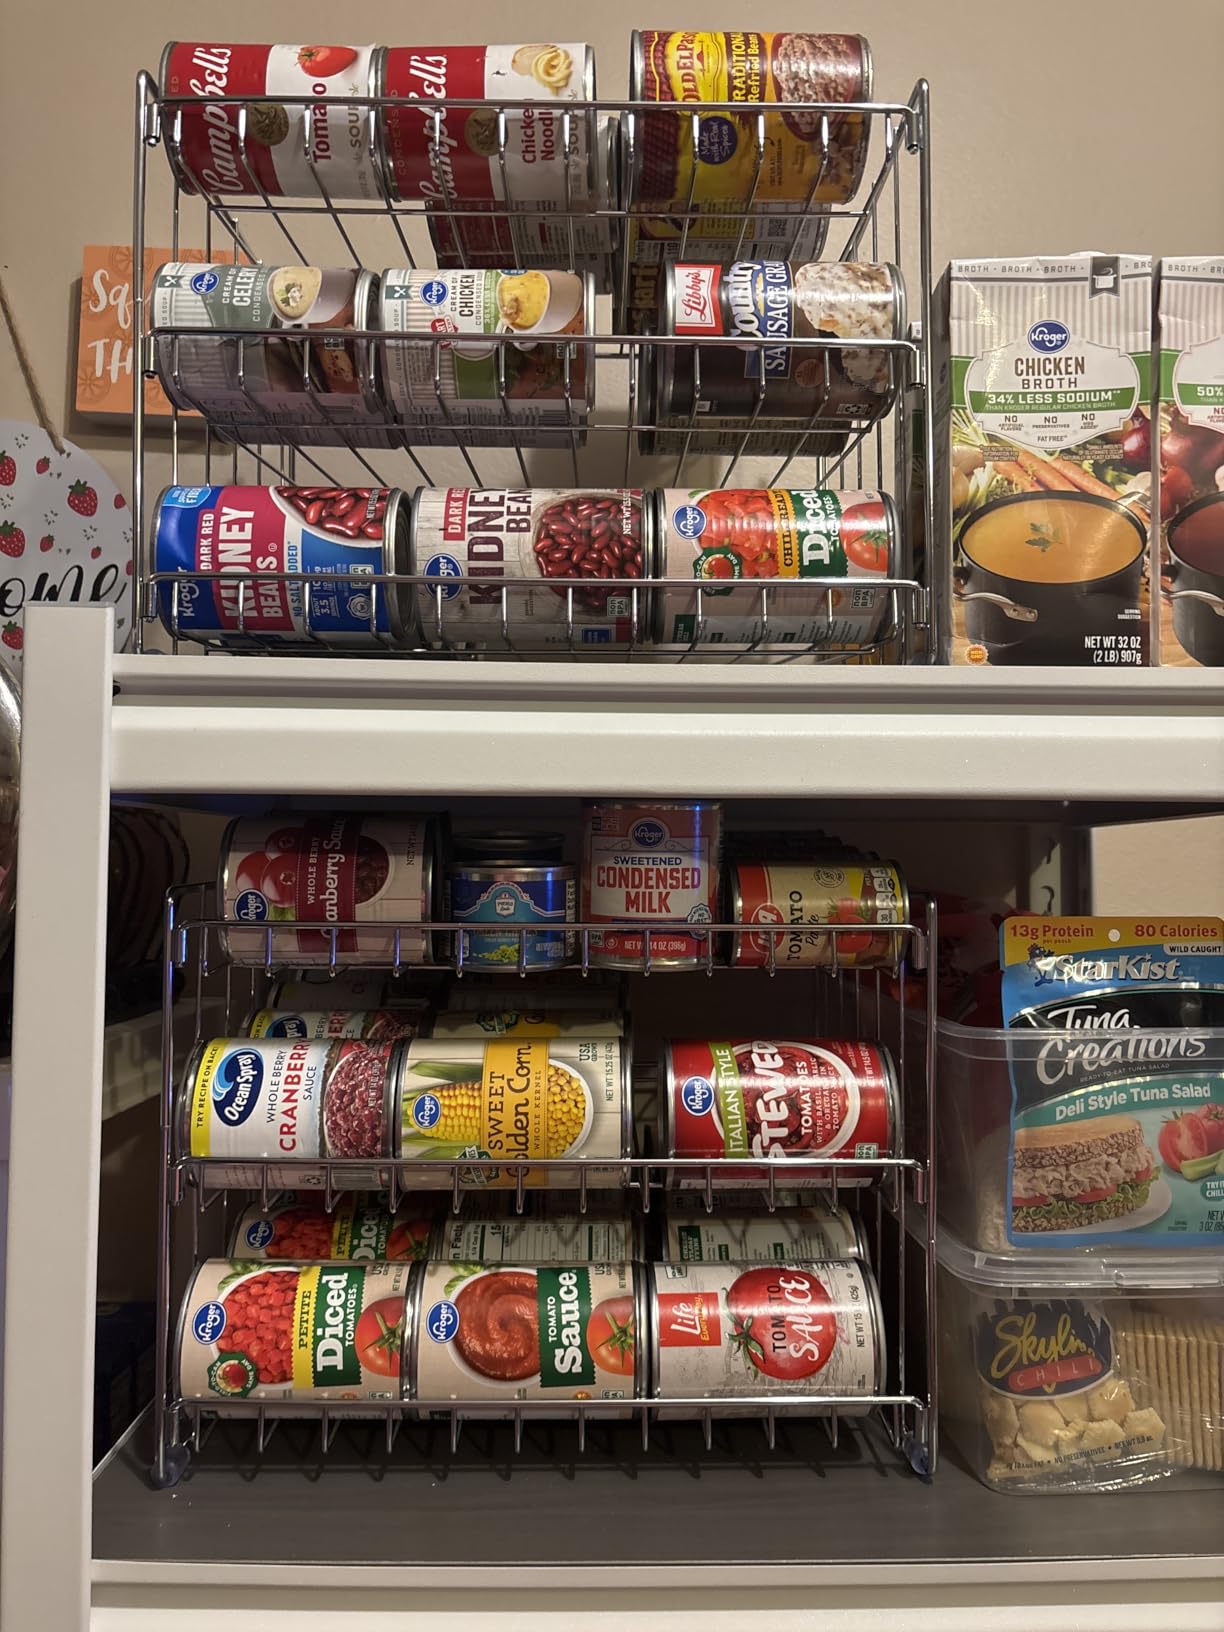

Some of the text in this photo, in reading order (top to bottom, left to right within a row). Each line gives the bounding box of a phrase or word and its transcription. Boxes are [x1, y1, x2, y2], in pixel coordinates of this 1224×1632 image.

[747, 56, 760, 101] Refried
[312, 83, 331, 164] Tomao
[391, 90, 406, 176] CONDENSD
[520, 98, 537, 164] Chicke
[539, 108, 555, 160] Noodl
[193, 272, 218, 293] Kroger
[958, 265, 1077, 274] BROTH BROTH BROTH
[1168, 264, 1199, 273] BROTH
[222, 278, 233, 304] CREAM
[232, 266, 259, 307] CELERY
[425, 281, 444, 305] Kroger
[459, 273, 476, 317] CHICKEN
[684, 269, 707, 321] Libby's
[764, 286, 789, 371] SAUSAGE
[1031, 327, 1068, 347] Kroger
[1014, 356, 1086, 377] CHICKEN
[987, 392, 1053, 405] 34% LESS
[1022, 378, 1078, 390] BROTH
[1197, 386, 1224, 397] 50%
[1004, 415, 1018, 423] NO
[1043, 416, 1058, 424] NO
[1081, 413, 1096, 421] NO
[447, 500, 463, 533] DARK
[506, 488, 533, 533] BEAN
[622, 519, 633, 535] NET
[680, 506, 701, 537] Kroger
[200, 512, 214, 570] DARK RED
[791, 489, 831, 567] Diced
[217, 506, 258, 618] KIDNEY
[467, 488, 506, 605] KIDNE
[177, 566, 200, 618] Krogr
[289, 581, 302, 602] SALT
[432, 556, 456, 598] Krger
[320, 599, 330, 614] 3.5
[609, 598, 617, 615] non
[617, 598, 625, 615] BPA
[861, 589, 869, 607] BPA
[1084, 636, 1142, 649] NET WT 32 OZ
[1093, 651, 1142, 665] (2 LB) 907g
[634, 826, 664, 843] Kroger
[307, 837, 320, 905] WHOLE BERRY
[407, 850, 417, 867] NET
[613, 856, 683, 866] SWEETENED
[596, 866, 702, 889] CONDENSED
[320, 853, 346, 939] Canberry
[625, 891, 672, 913] MILK
[787, 891, 802, 961] TOMATO
[805, 913, 821, 947] Pate
[1010, 924, 1094, 940] 13g Protein
[1134, 924, 1218, 937] 80 Calories
[624, 939, 667, 950] NET OZ
[1190, 945, 1222, 954] CAUGHT
[1054, 953, 1181, 982] StarKist
[1048, 1005, 1131, 1033] Tuna
[579, 1042, 591, 1062] USA
[1036, 1030, 1211, 1086] Creations
[1128, 1065, 1147, 1073] TUNA
[1148, 1063, 1171, 1071] SALAD
[303, 1066, 317, 1101] SAUCE
[507, 1046, 532, 1094] Corn
[196, 1065, 211, 1128] TRY RECIPE ON
[224, 1054, 257, 1121] Ocean Spray
[266, 1050, 286, 1124] WHOLE BERRY
[279, 1040, 311, 1152] CRANBERRY
[605, 1077, 614, 1102] NET WT
[687, 1080, 709, 1111] Kroger
[717, 1048, 744, 1152] ITALIAN STYLE
[1055, 1083, 1212, 1121] Deli Style Tuna Salad
[417, 1095, 437, 1127] Kroger
[488, 1071, 505, 1150] SWEET
[533, 1070, 542, 1151] WHOLE KERNEL
[751, 1041, 789, 1169] STEWED
[832, 1092, 840, 1130] TOMATO
[816, 1120, 824, 1144] WITH
[1206, 1182, 1219, 1190] TRY
[1207, 1210, 1220, 1220] NET
[248, 1222, 271, 1248] Kroger
[351, 1208, 380, 1261] Dice
[199, 1303, 222, 1342] Kroger
[297, 1290, 312, 1349] PETITE
[315, 1272, 350, 1373] Diced
[343, 1288, 358, 1347] TOMATOES
[432, 1303, 455, 1341] Kroger
[547, 1296, 558, 1343] TOMATO
[554, 1271, 583, 1374] Sauce
[670, 1302, 701, 1335] Life
[766, 1284, 787, 1353] TOMTO
[779, 1276, 824, 1362] SAUCE
[848, 1285, 866, 1348] NET WT 15 (425g)
[1015, 1356, 1098, 1386] CHILI
